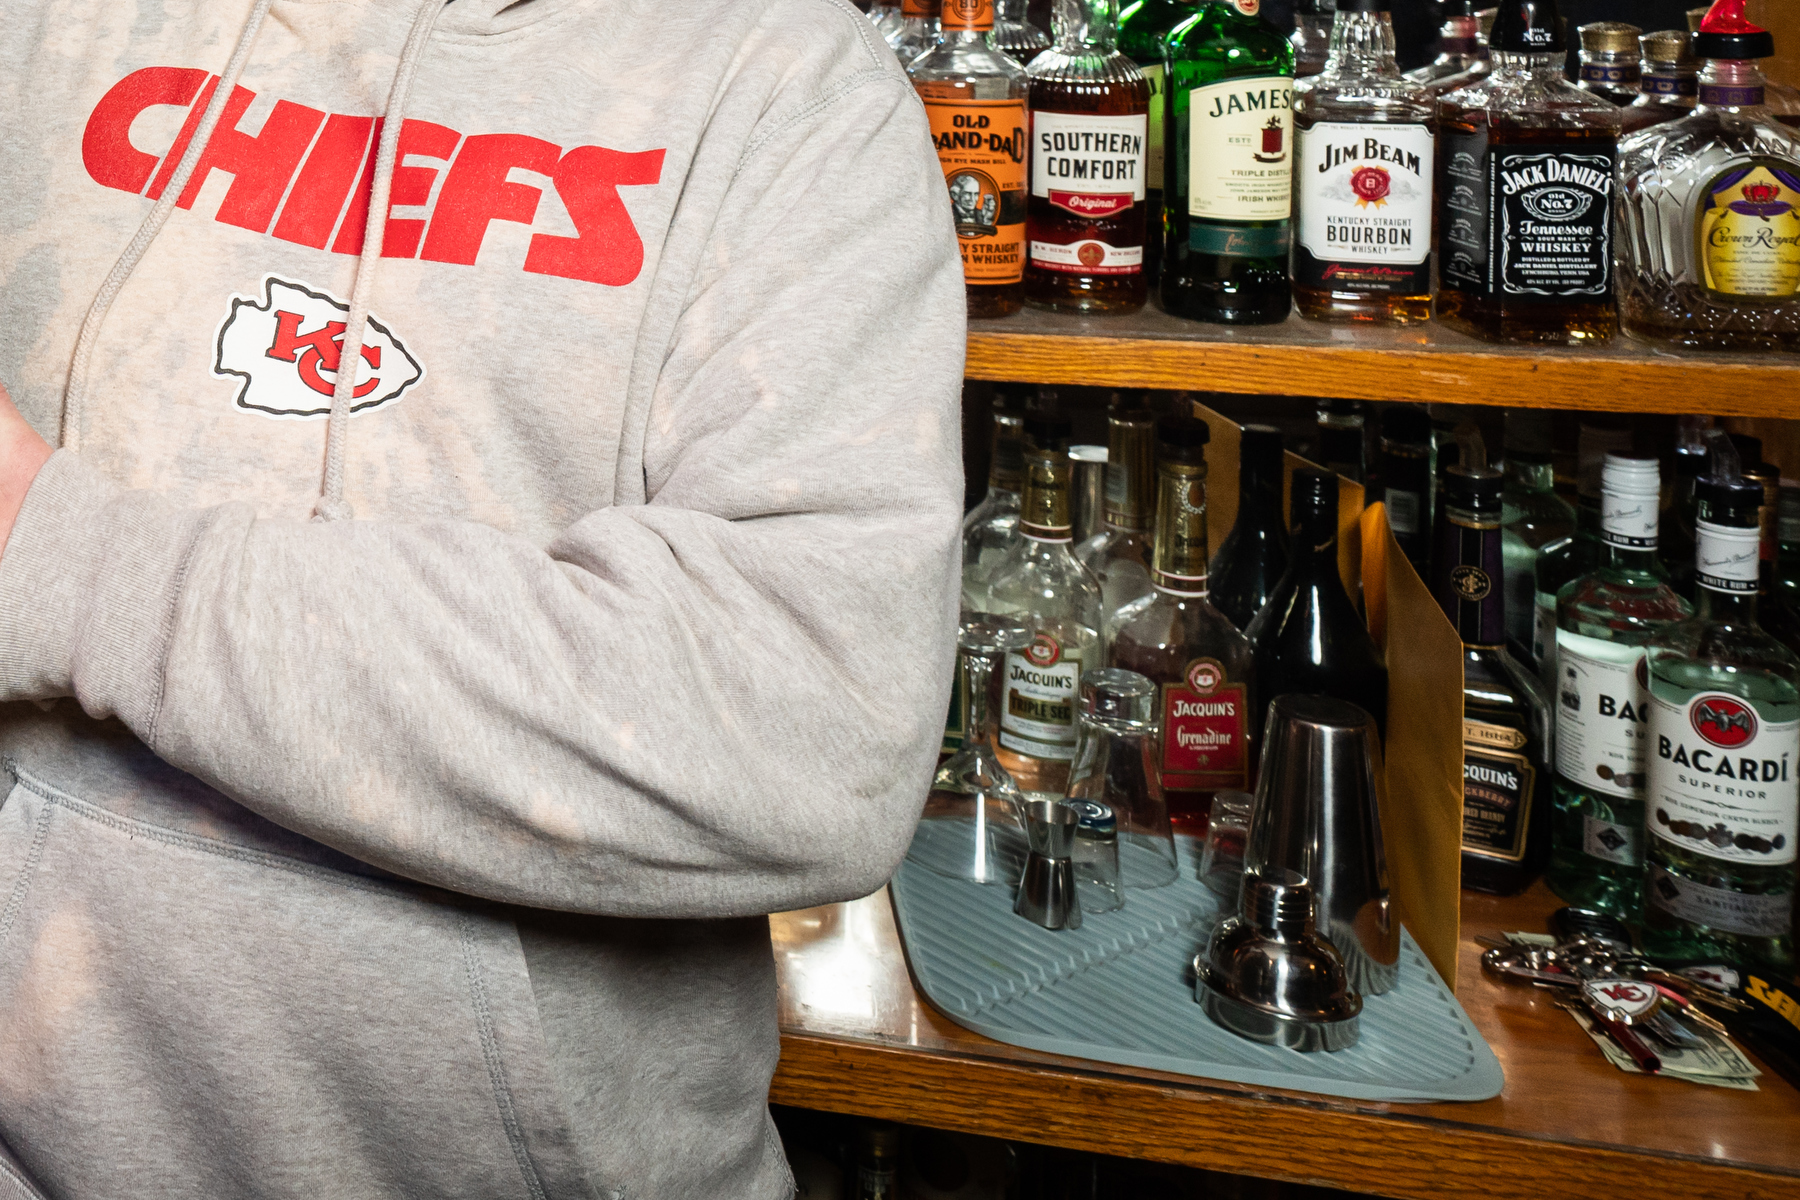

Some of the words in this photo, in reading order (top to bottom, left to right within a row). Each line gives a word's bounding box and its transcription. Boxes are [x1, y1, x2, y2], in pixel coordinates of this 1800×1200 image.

[1522, 32, 1552, 42] No.7
[952, 114, 990, 128] OLD
[1041, 132, 1142, 156] SOUTHERN
[1318, 144, 1359, 174] JIM
[1364, 137, 1422, 177] BEAM
[1047, 156, 1136, 180] COMFORT
[1231, 169, 1265, 178] TRIPLE
[81, 65, 667, 288] CHIEFS
[1501, 164, 1547, 195] JACK
[1547, 158, 1614, 196] DANIEL'S
[1068, 195, 1117, 209] Original
[1237, 195, 1264, 203] IRISH
[1540, 198, 1573, 209] No.7
[1327, 215, 1370, 225] KENTUCKY
[1373, 217, 1412, 227] STRAIGHT
[1519, 220, 1593, 235] Tennessee
[1327, 225, 1412, 245] BOURBON
[1709, 226, 1753, 248] Crown
[1743, 226, 1800, 249] Royal
[972, 242, 1020, 254] STRAIGHT
[1351, 245, 1388, 255] WHISKEY
[1520, 242, 1592, 253] WHISKEY
[973, 253, 1019, 265] WHISKEY
[1612, 533, 1630, 545] RUM
[1702, 575, 1728, 588] WHITE
[1729, 579, 1748, 589] RUM
[1010, 665, 1072, 689] JACQUIN'S
[1010, 696, 1047, 717] TRIPLE
[1050, 704, 1072, 719] SEC
[1172, 700, 1235, 717] JACQUIN'S
[1176, 724, 1232, 748] Grenadine
[1658, 734, 1788, 782] BACARDÍ
[1463, 764, 1518, 790] CQUIN'S
[1678, 774, 1768, 799] SUPERIOR
